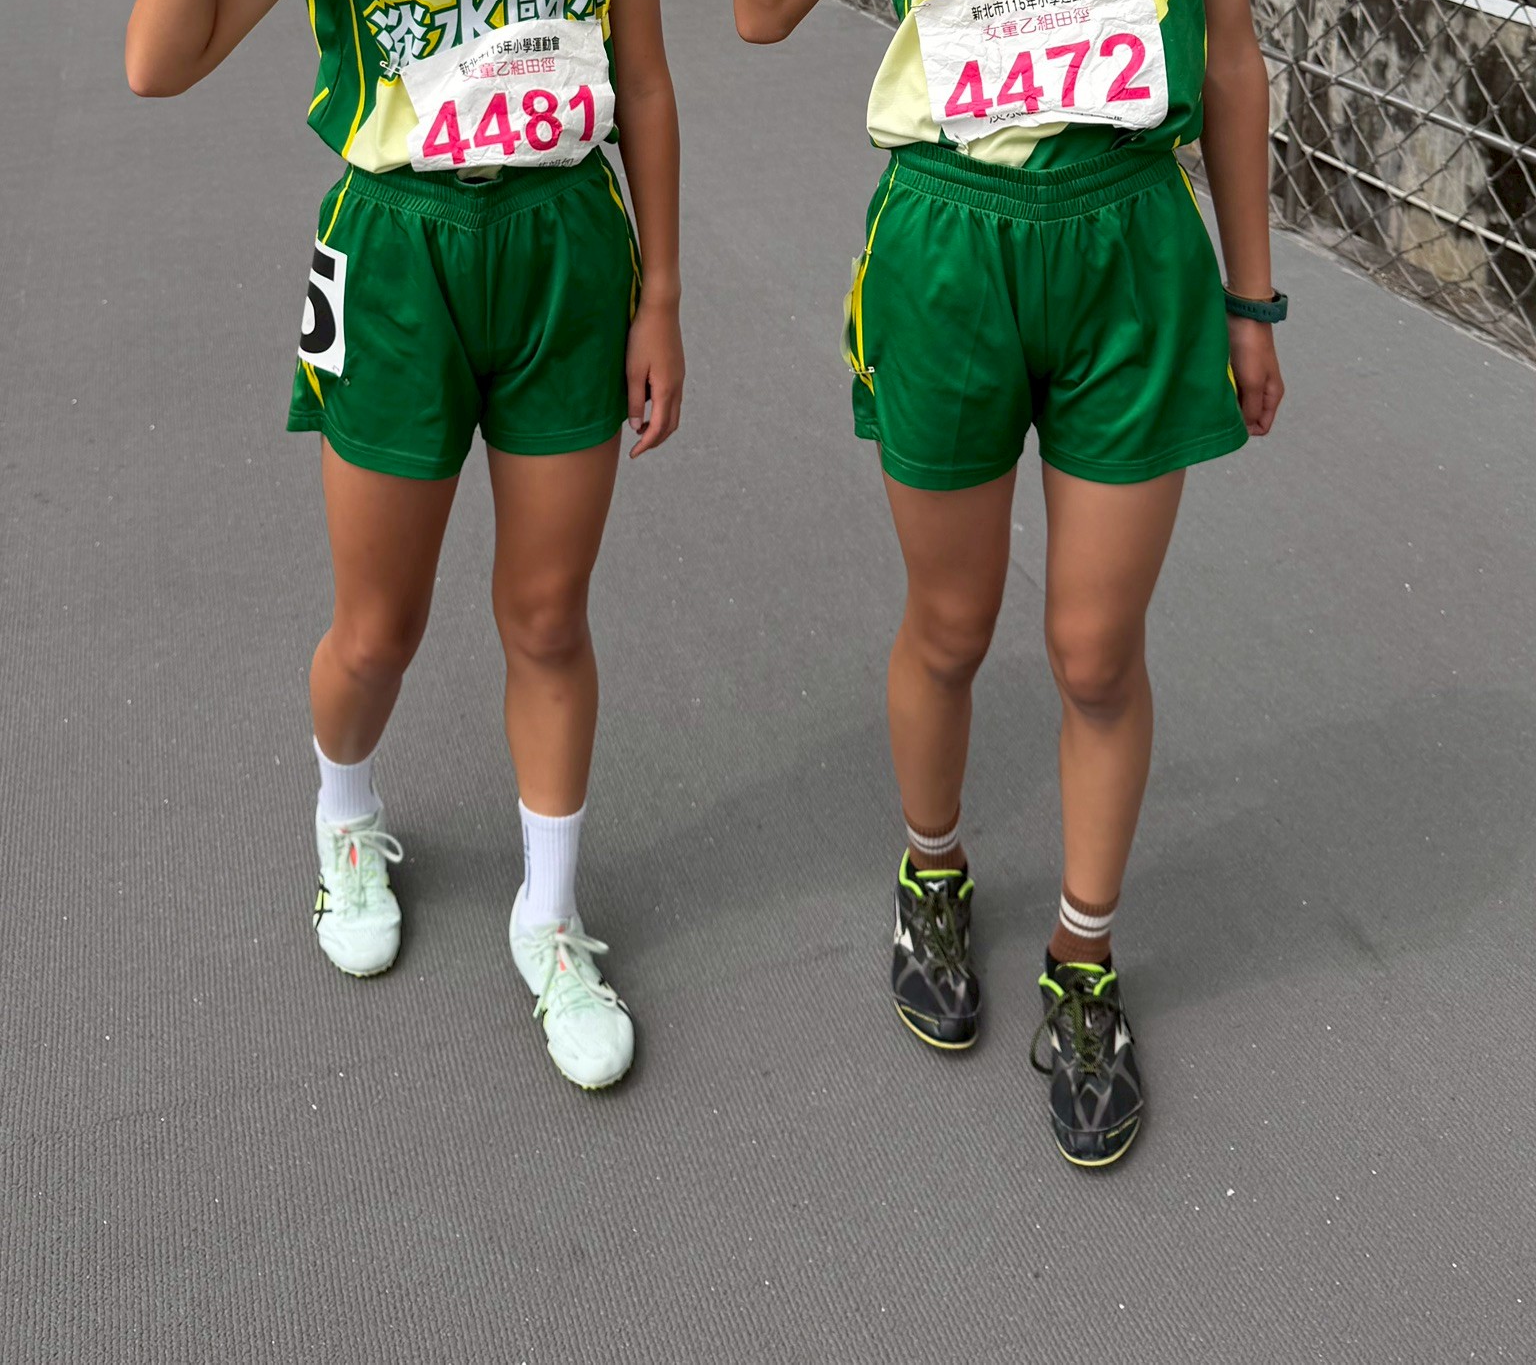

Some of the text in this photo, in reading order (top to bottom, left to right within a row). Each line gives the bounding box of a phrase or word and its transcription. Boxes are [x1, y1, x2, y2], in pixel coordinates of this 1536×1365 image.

[983, 6, 1092, 42] 女童乙組田徑
[945, 33, 1151, 119] 4472
[422, 84, 594, 165] 4481
[300, 246, 337, 354] 5
